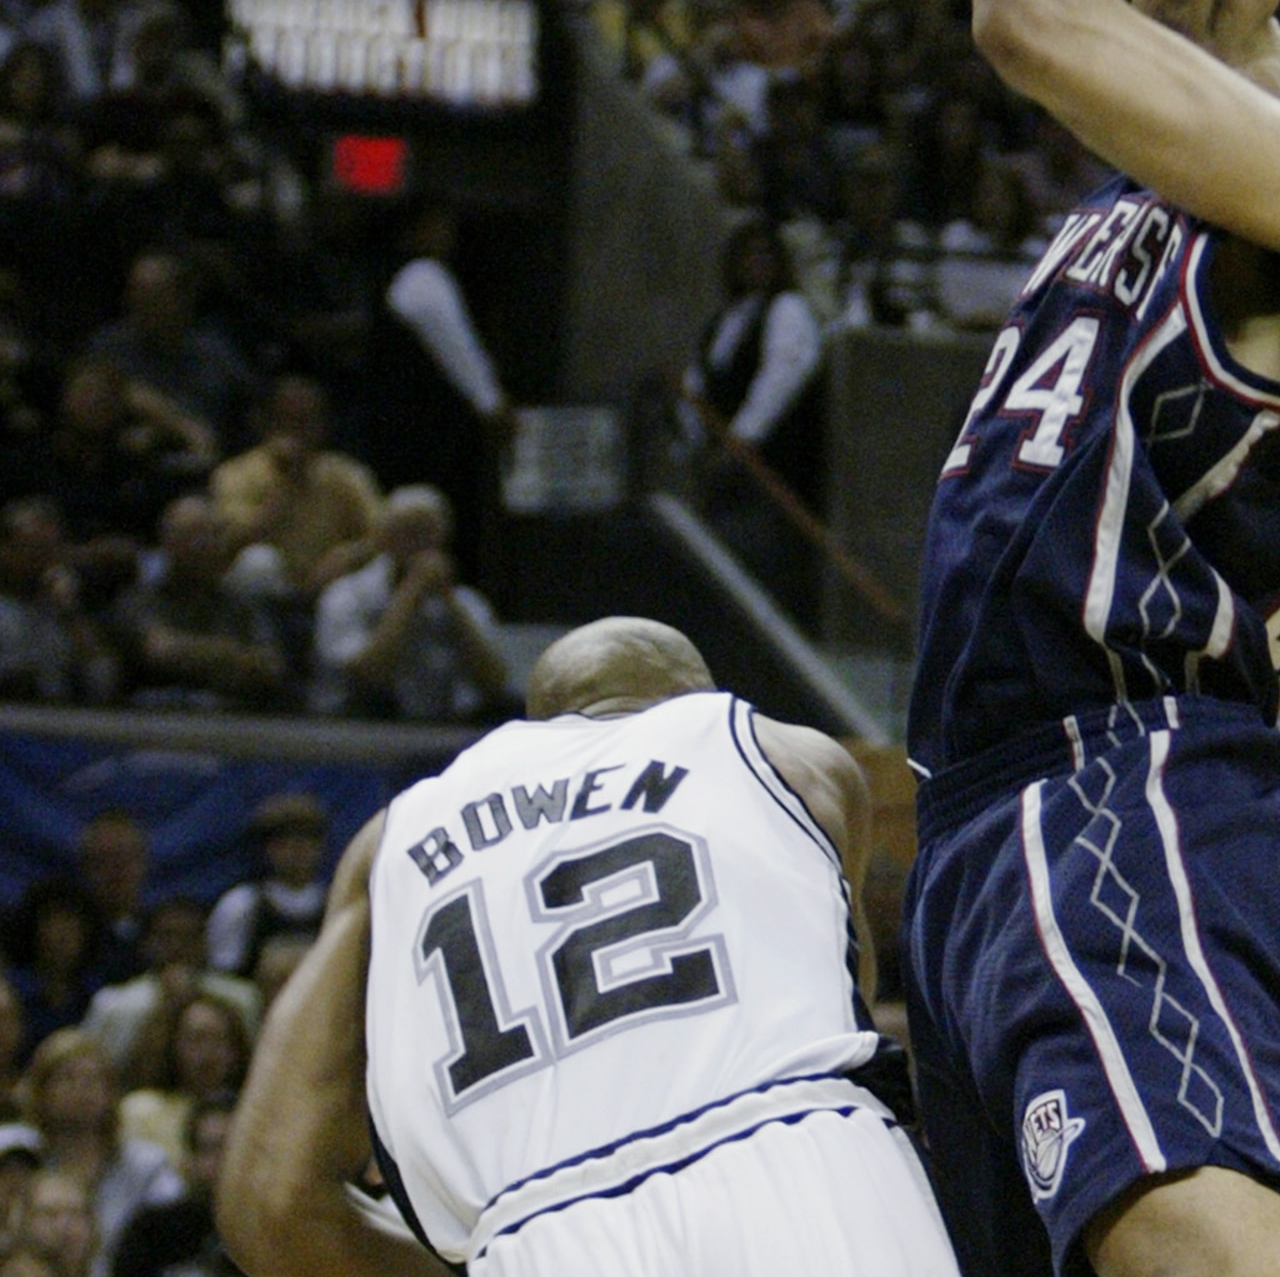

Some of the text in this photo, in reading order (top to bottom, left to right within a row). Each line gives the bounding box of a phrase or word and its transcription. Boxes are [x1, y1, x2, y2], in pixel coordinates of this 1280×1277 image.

[941, 314, 1101, 480] 24
[407, 759, 690, 887] BOWEN
[412, 822, 739, 1119] 12
